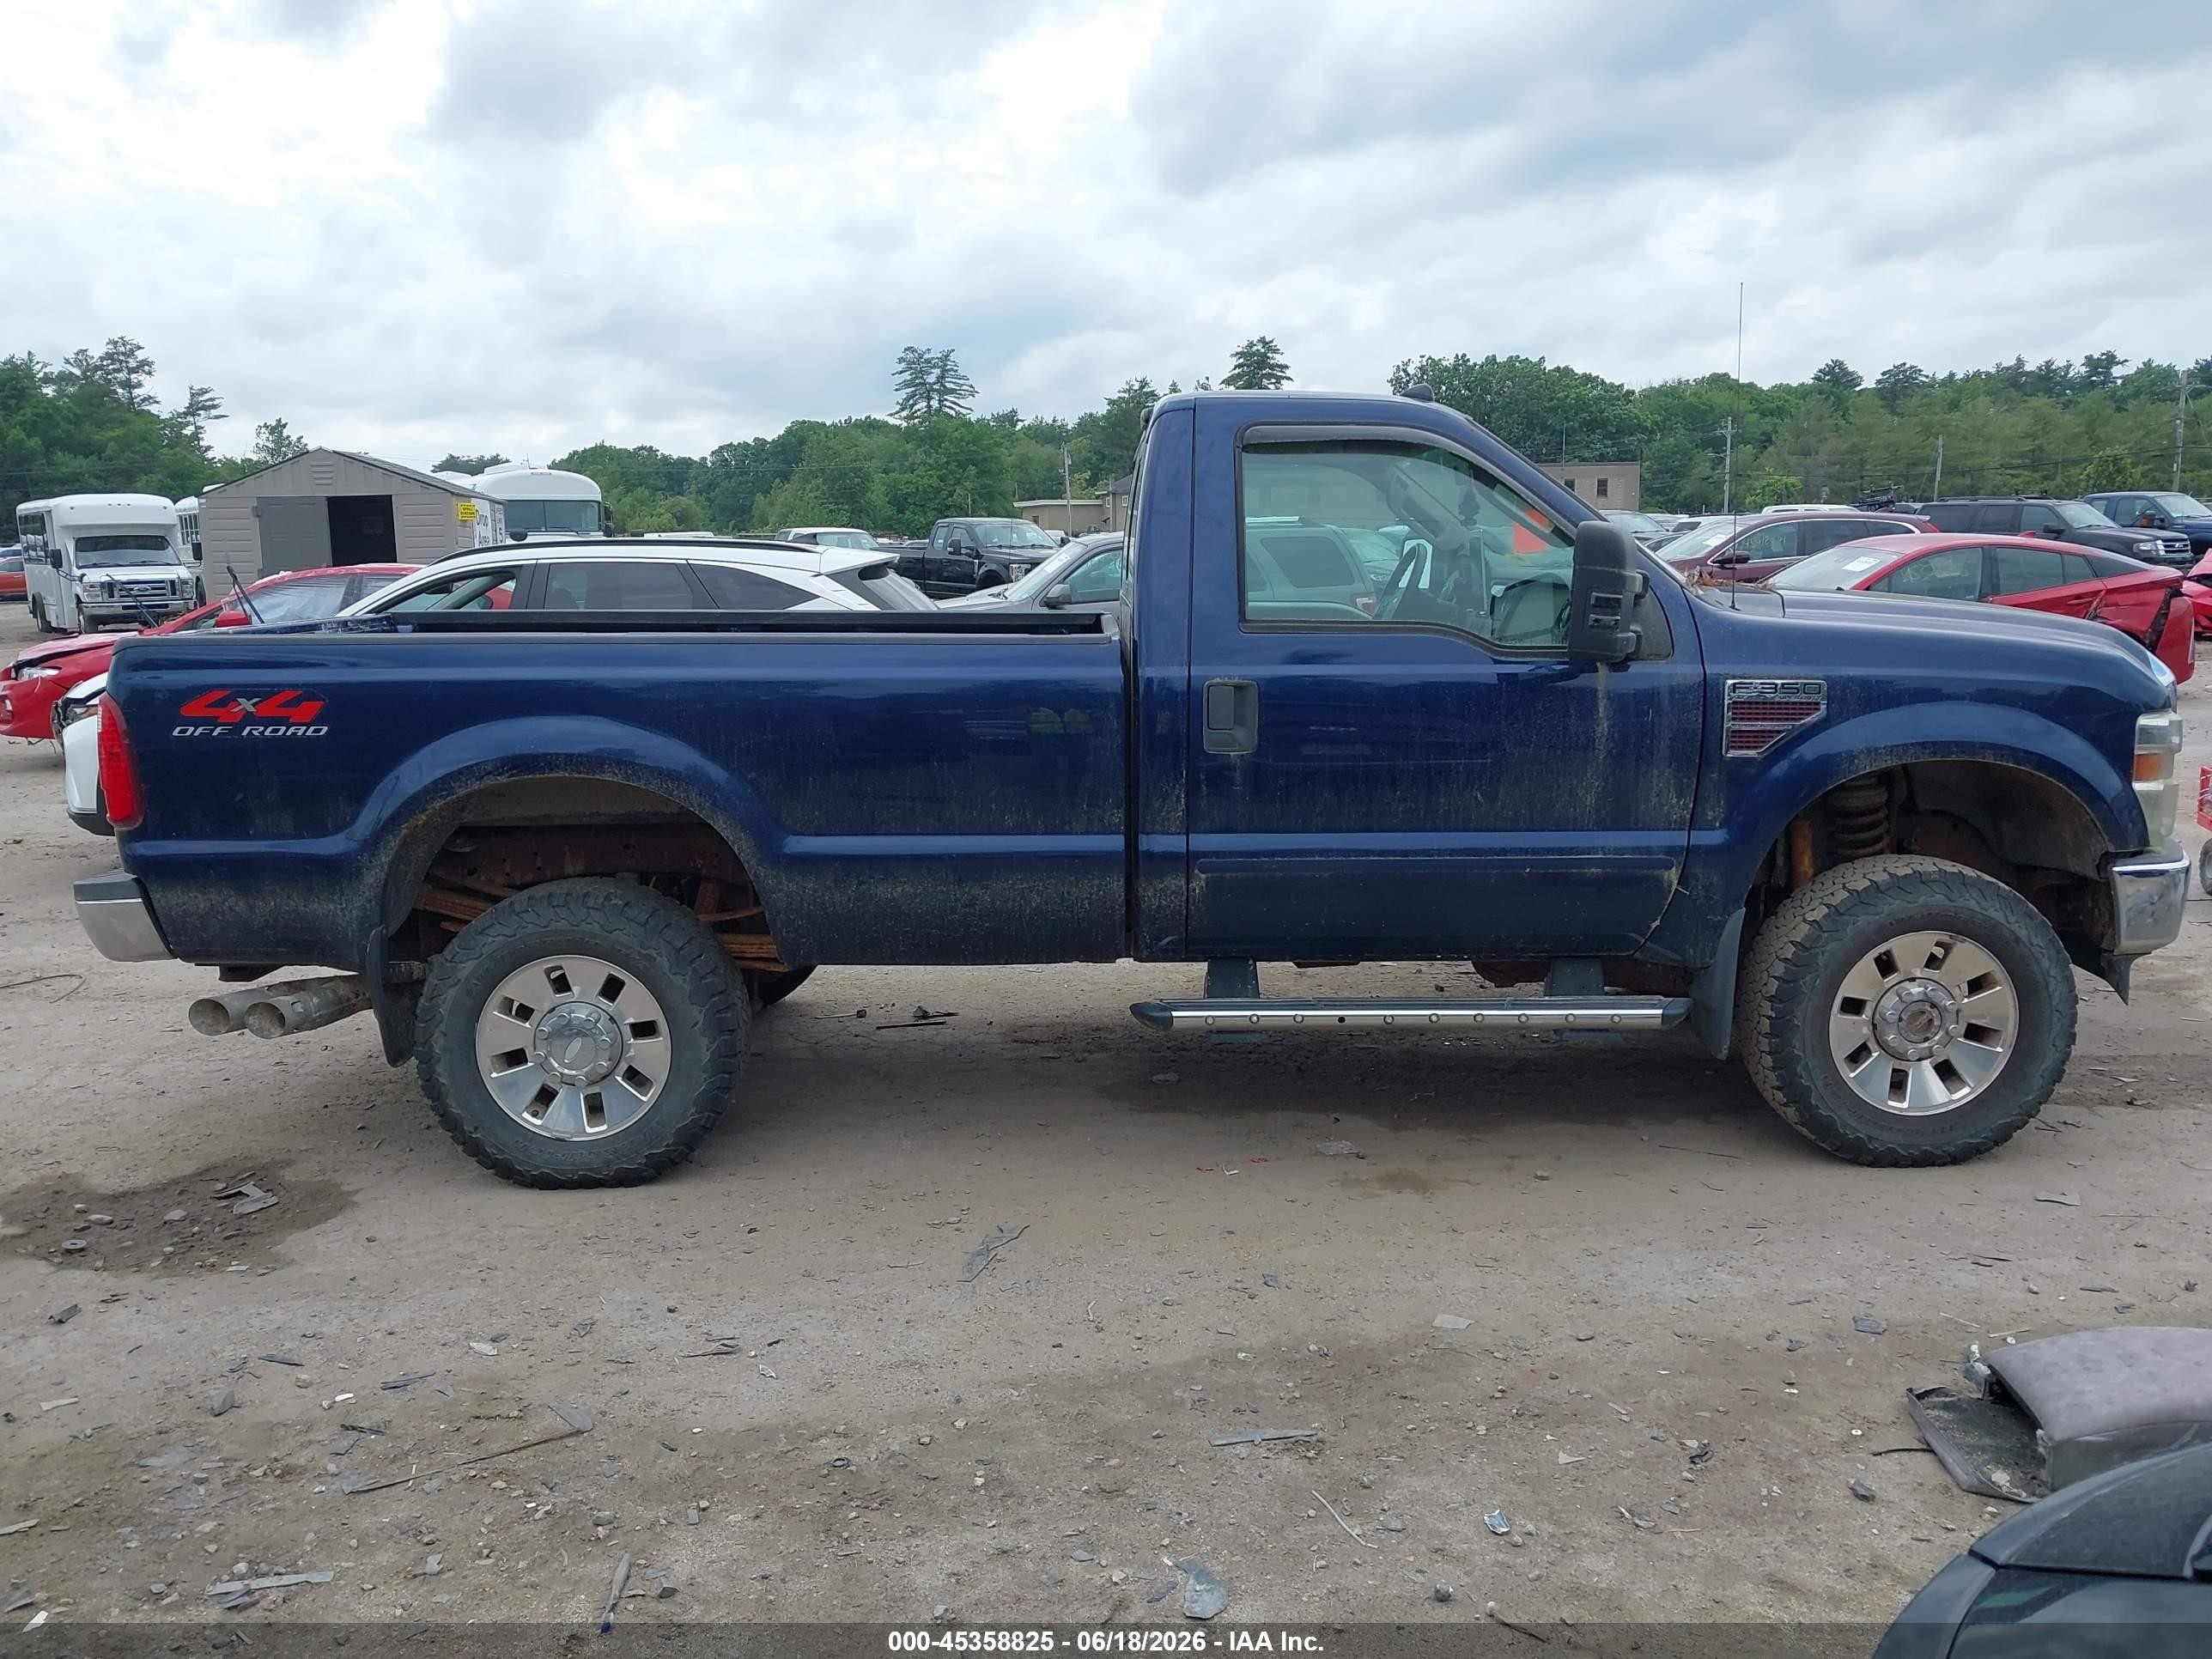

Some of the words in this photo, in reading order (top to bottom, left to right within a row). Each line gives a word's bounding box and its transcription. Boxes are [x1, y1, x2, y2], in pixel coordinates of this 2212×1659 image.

[475, 508, 489, 529] Drop
[477, 531, 490, 547] Area
[172, 726, 234, 737] OFF
[241, 726, 330, 737] ROAD
